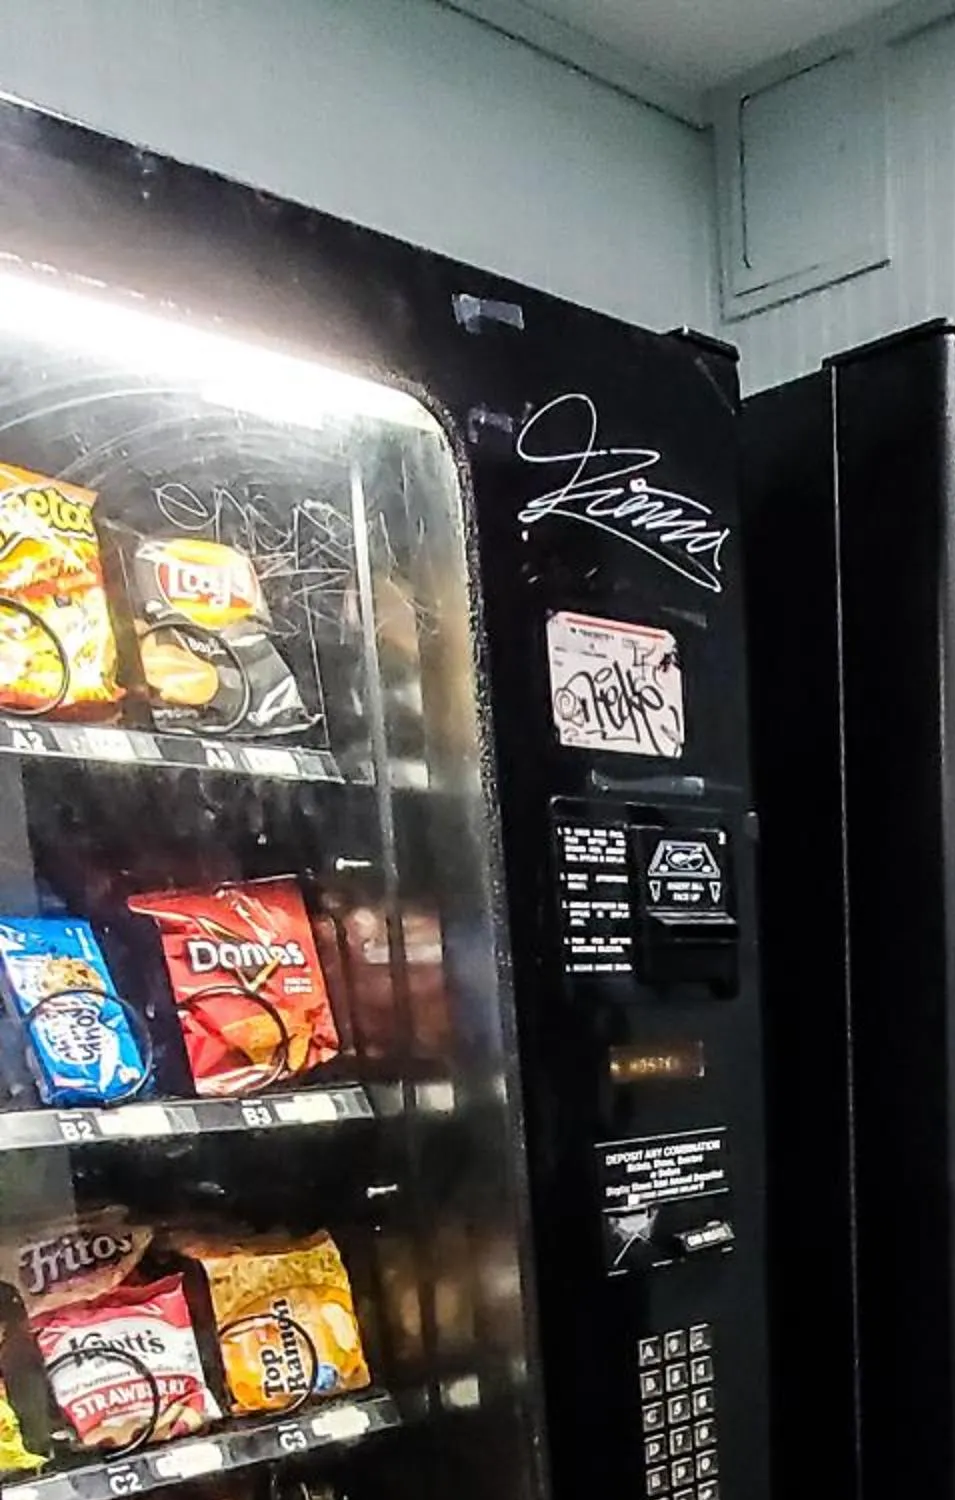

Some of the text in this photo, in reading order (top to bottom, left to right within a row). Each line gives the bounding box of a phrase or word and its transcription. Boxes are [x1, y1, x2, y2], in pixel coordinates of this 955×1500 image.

[186, 938, 306, 973] Doritos
[244, 1105, 273, 1127] B3
[60, 1121, 96, 1142] B2
[605, 1149, 643, 1166] DEPOSIT
[19, 1230, 133, 1294] Fritos
[260, 1349, 284, 1399] Top
[71, 1378, 186, 1419] STRAWBRRY
[280, 1430, 307, 1451] C3
[109, 1474, 143, 1495] C2
